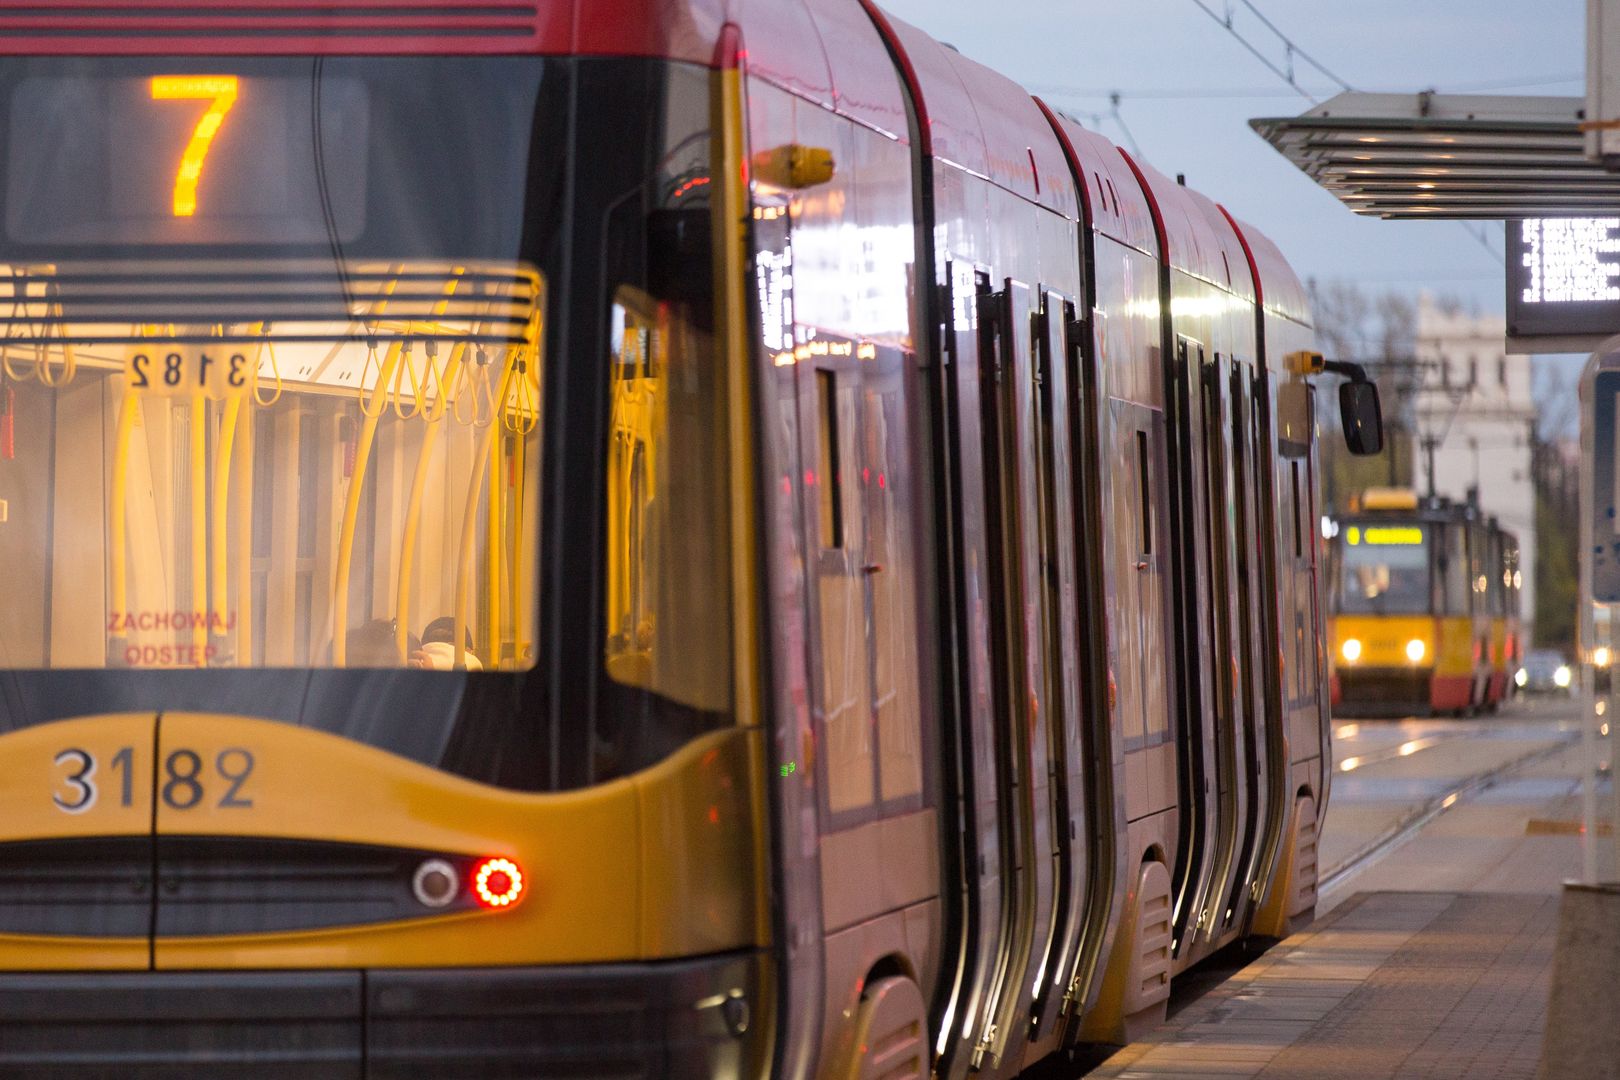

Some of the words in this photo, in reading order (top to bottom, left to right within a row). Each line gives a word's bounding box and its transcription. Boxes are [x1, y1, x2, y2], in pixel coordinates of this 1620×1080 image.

[151, 74, 239, 217] 7
[108, 611, 236, 632] ZACHOWAJ
[52, 746, 254, 815] 3182
